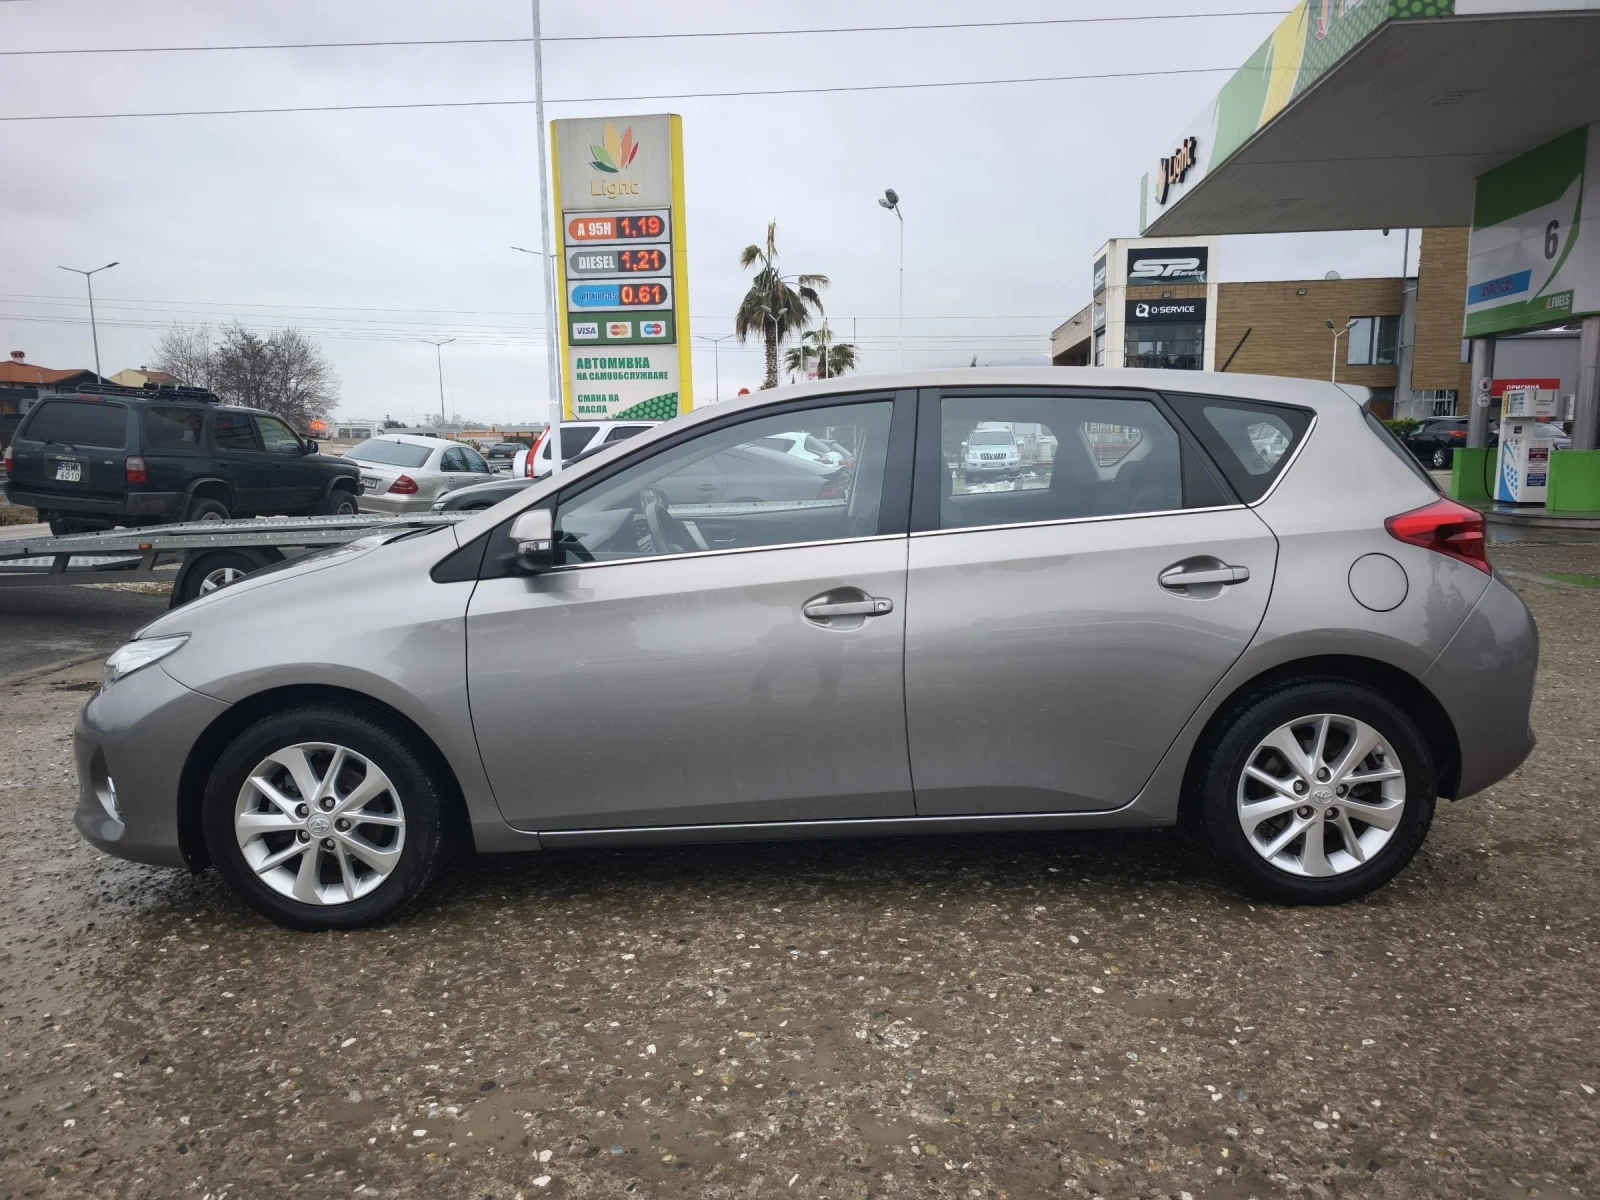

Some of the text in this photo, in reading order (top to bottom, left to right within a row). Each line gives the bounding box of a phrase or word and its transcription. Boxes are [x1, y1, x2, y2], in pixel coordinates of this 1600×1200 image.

[591, 177, 639, 200] Light
[1545, 219, 1559, 260] 6
[579, 256, 615, 269] DIESEL
[1129, 258, 1200, 278] SP
[1482, 279, 1514, 298] AUTO GAS
[602, 291, 617, 300] GAS
[577, 327, 596, 335] VISA
[576, 357, 650, 370] АВТОМИВКА
[577, 372, 669, 381] НА САМООБСЛУЖВАНЕ
[578, 394, 620, 403] СМЯНА НА
[578, 405, 608, 414] МАСЛА
